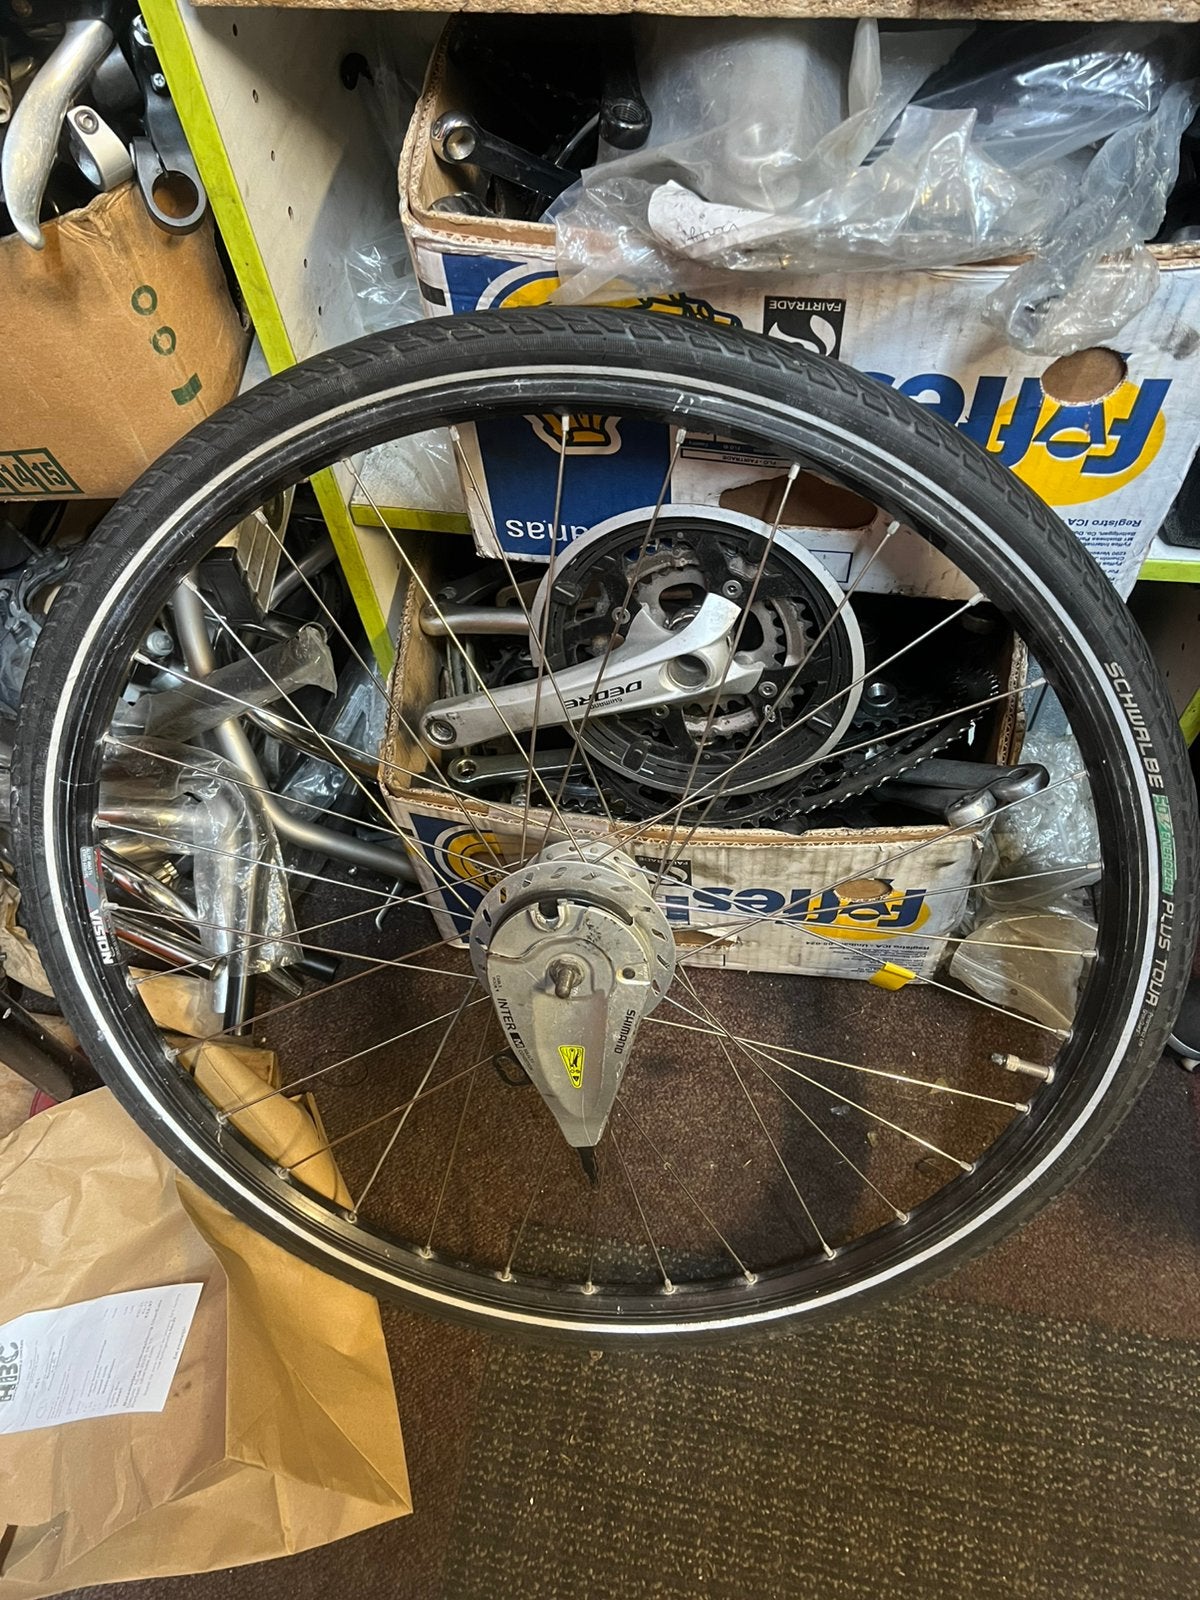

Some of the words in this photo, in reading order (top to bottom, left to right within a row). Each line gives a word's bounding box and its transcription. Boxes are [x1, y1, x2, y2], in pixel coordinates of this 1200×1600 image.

[768, 299, 842, 313] FAIRTRADE
[0, 463, 37, 487] 14
[31, 461, 67, 486] 15
[505, 519, 588, 543] anas
[1067, 518, 1089, 526] ICA
[1091, 518, 1142, 528] Registro
[564, 680, 642, 710] DEORE
[1104, 661, 1164, 789] SCHWALBE
[637, 857, 689, 866] FAIRADE
[1160, 830, 1175, 893] ENERGIZER
[89, 909, 114, 965] VISION
[1157, 899, 1175, 952] PLUS
[1144, 958, 1168, 1007] TOUR
[497, 998, 517, 1031] INTER
[614, 1009, 635, 1053] SHIMANO
